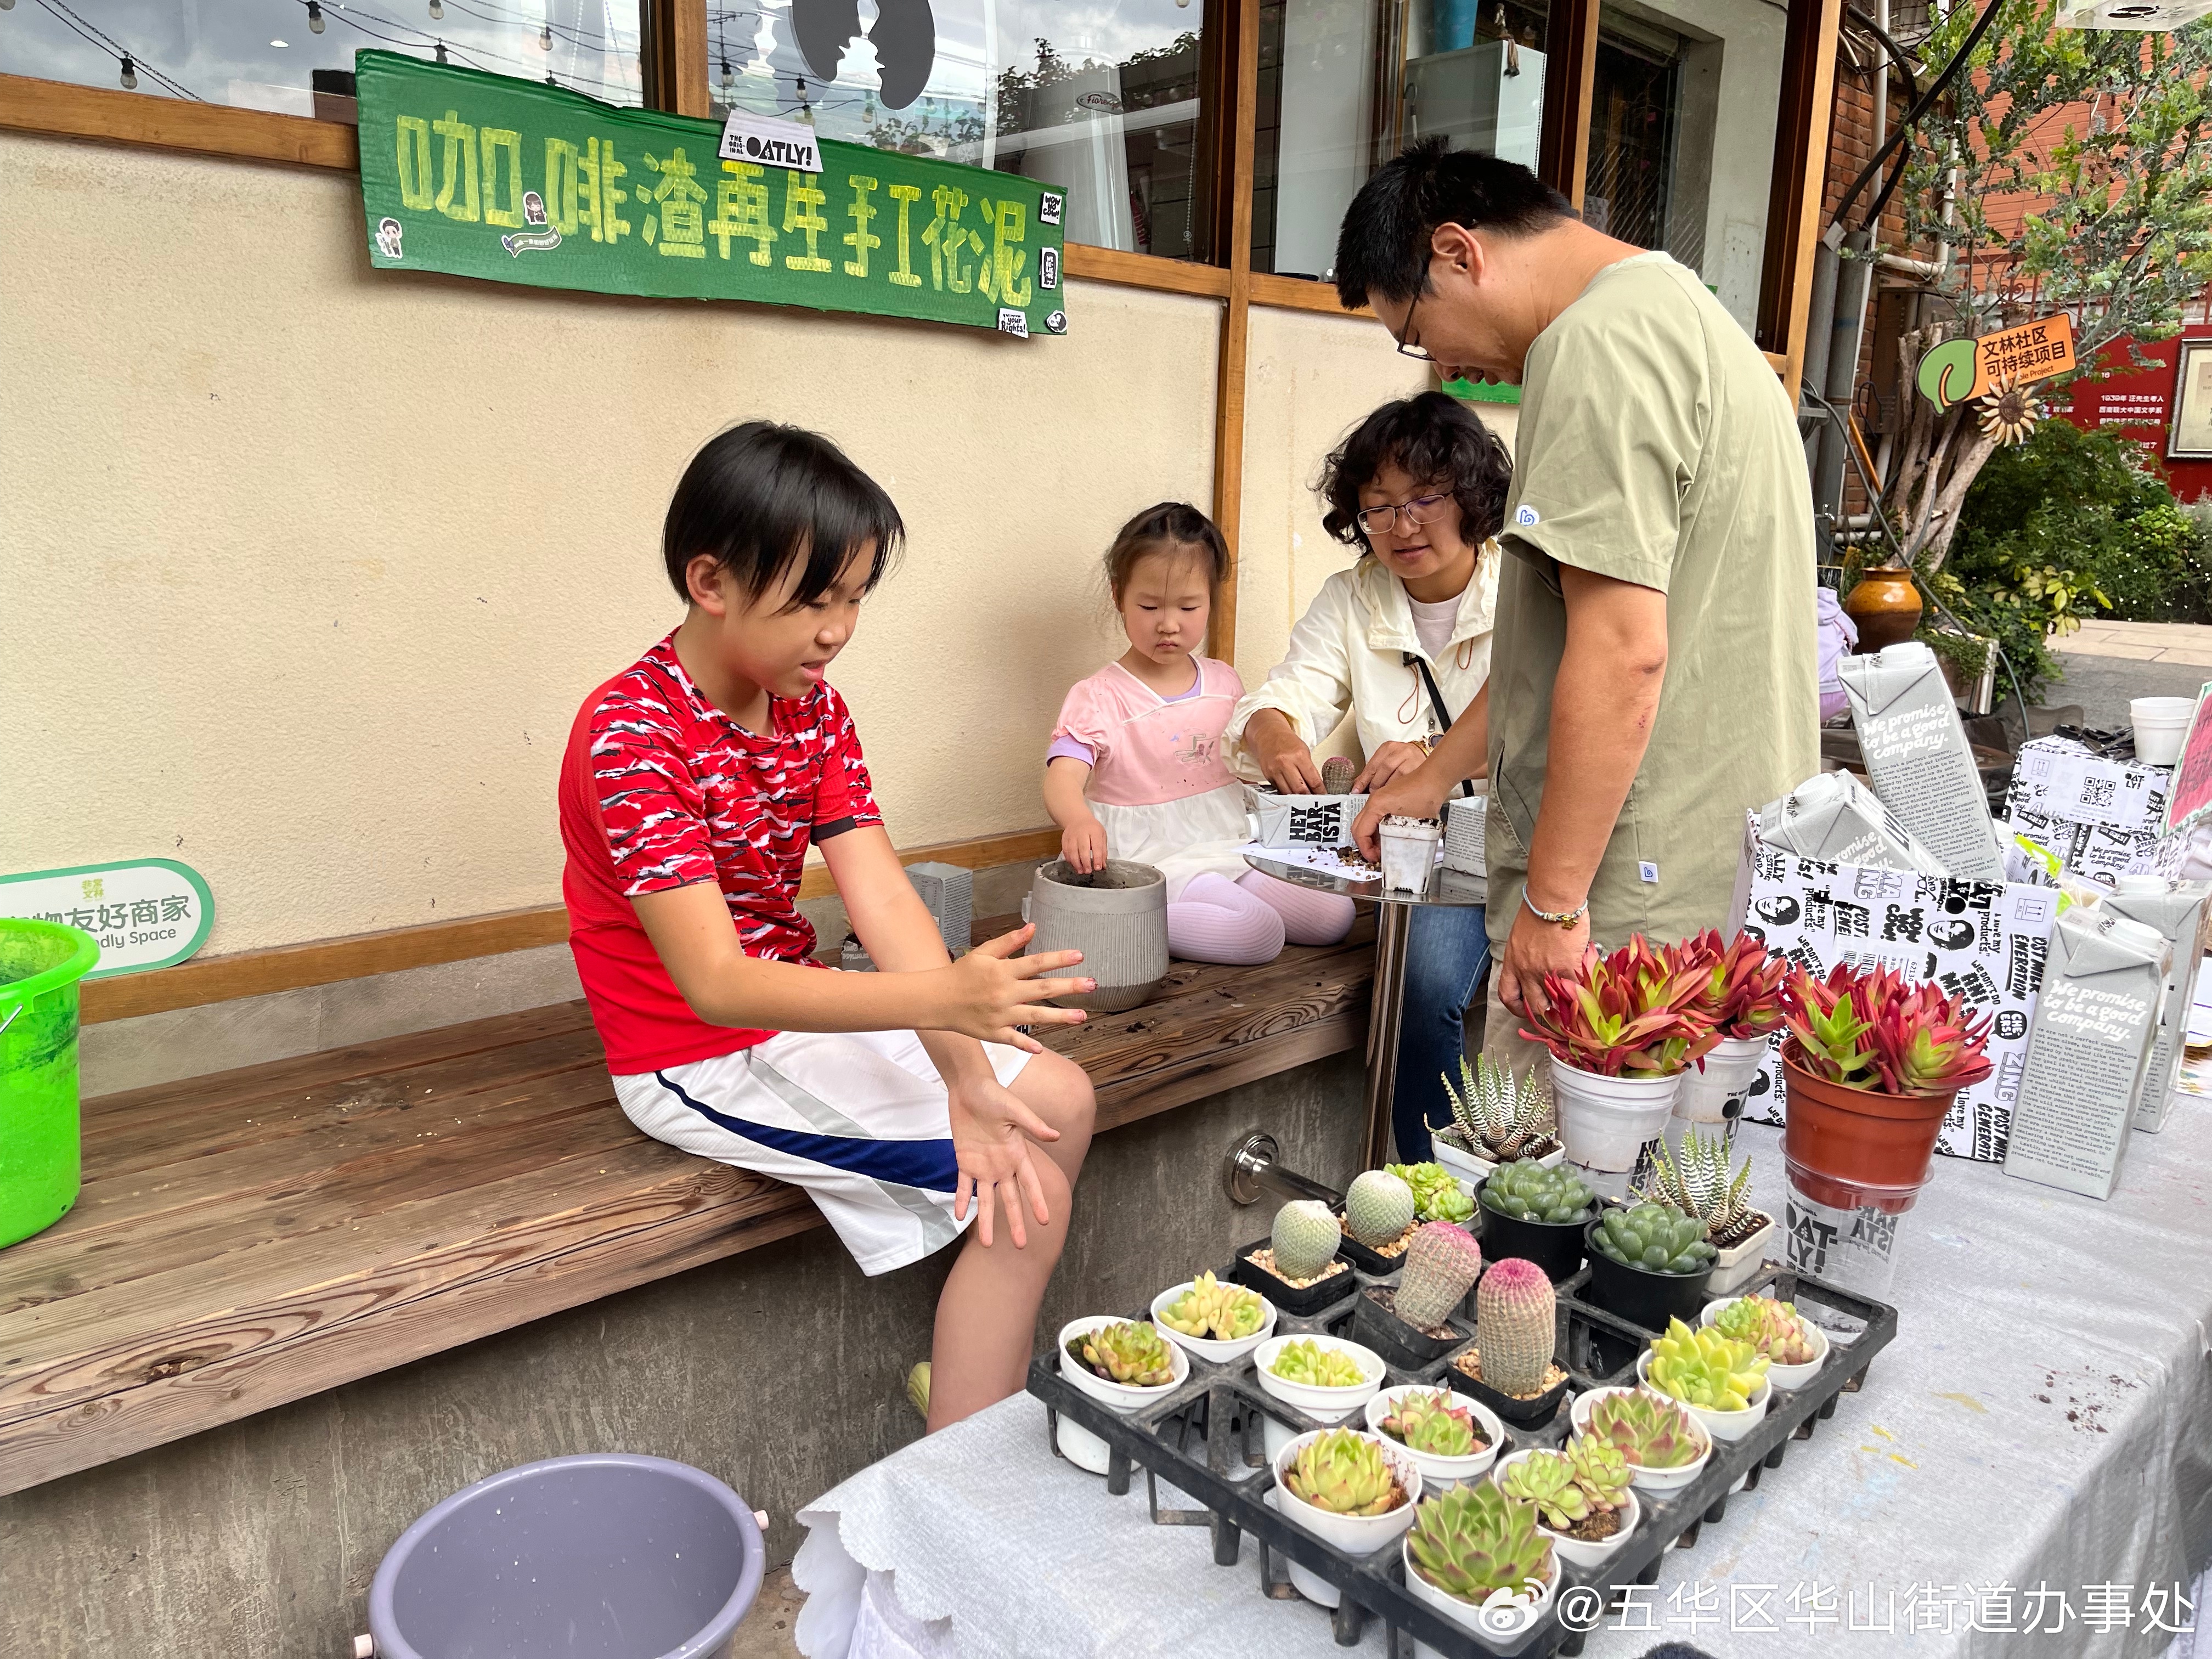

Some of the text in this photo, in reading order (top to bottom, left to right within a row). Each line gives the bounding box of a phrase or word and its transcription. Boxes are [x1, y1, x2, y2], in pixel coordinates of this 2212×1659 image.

[747, 137, 812, 166] OATLY!
[396, 110, 1031, 307] 咖啡渣再生手工花泥
[1043, 208, 1059, 219] COW!
[1045, 195, 1060, 206] WOW
[1001, 320, 1025, 334] Rights!
[1982, 325, 2048, 359] 文林社区
[1985, 341, 2066, 377] 可持续项目
[2030, 365, 2054, 379] Project
[1862, 704, 1945, 736] We promise
[1863, 710, 1950, 749] to be a good
[1873, 733, 1948, 759] company.
[2125, 772, 2145, 782] OAT-
[1289, 806, 1307, 840] HEY
[1305, 801, 1323, 842] BAR-
[1322, 802, 1341, 843] ISTA
[1837, 831, 1877, 861] romise
[2091, 859, 2126, 871] company.
[129, 928, 176, 945] Space
[1880, 904, 1901, 942] COW!
[1897, 913, 1910, 934] NO
[1906, 908, 1925, 944] WOW
[2029, 960, 2046, 994] MILK
[2043, 994, 2148, 1026] to be a good
[2050, 979, 2146, 1011] We promise
[2000, 1013, 2012, 1036] ERS!
[2047, 1011, 2131, 1042] company.
[1953, 1116, 1964, 1130] my
[1977, 1103, 1993, 1160] GENERATI
[1993, 1106, 2010, 1136] POST
[1793, 1199, 1818, 1217] ORIGINAL
[1786, 1202, 1838, 1249] OAT-
[1786, 1231, 1826, 1274] LY!
